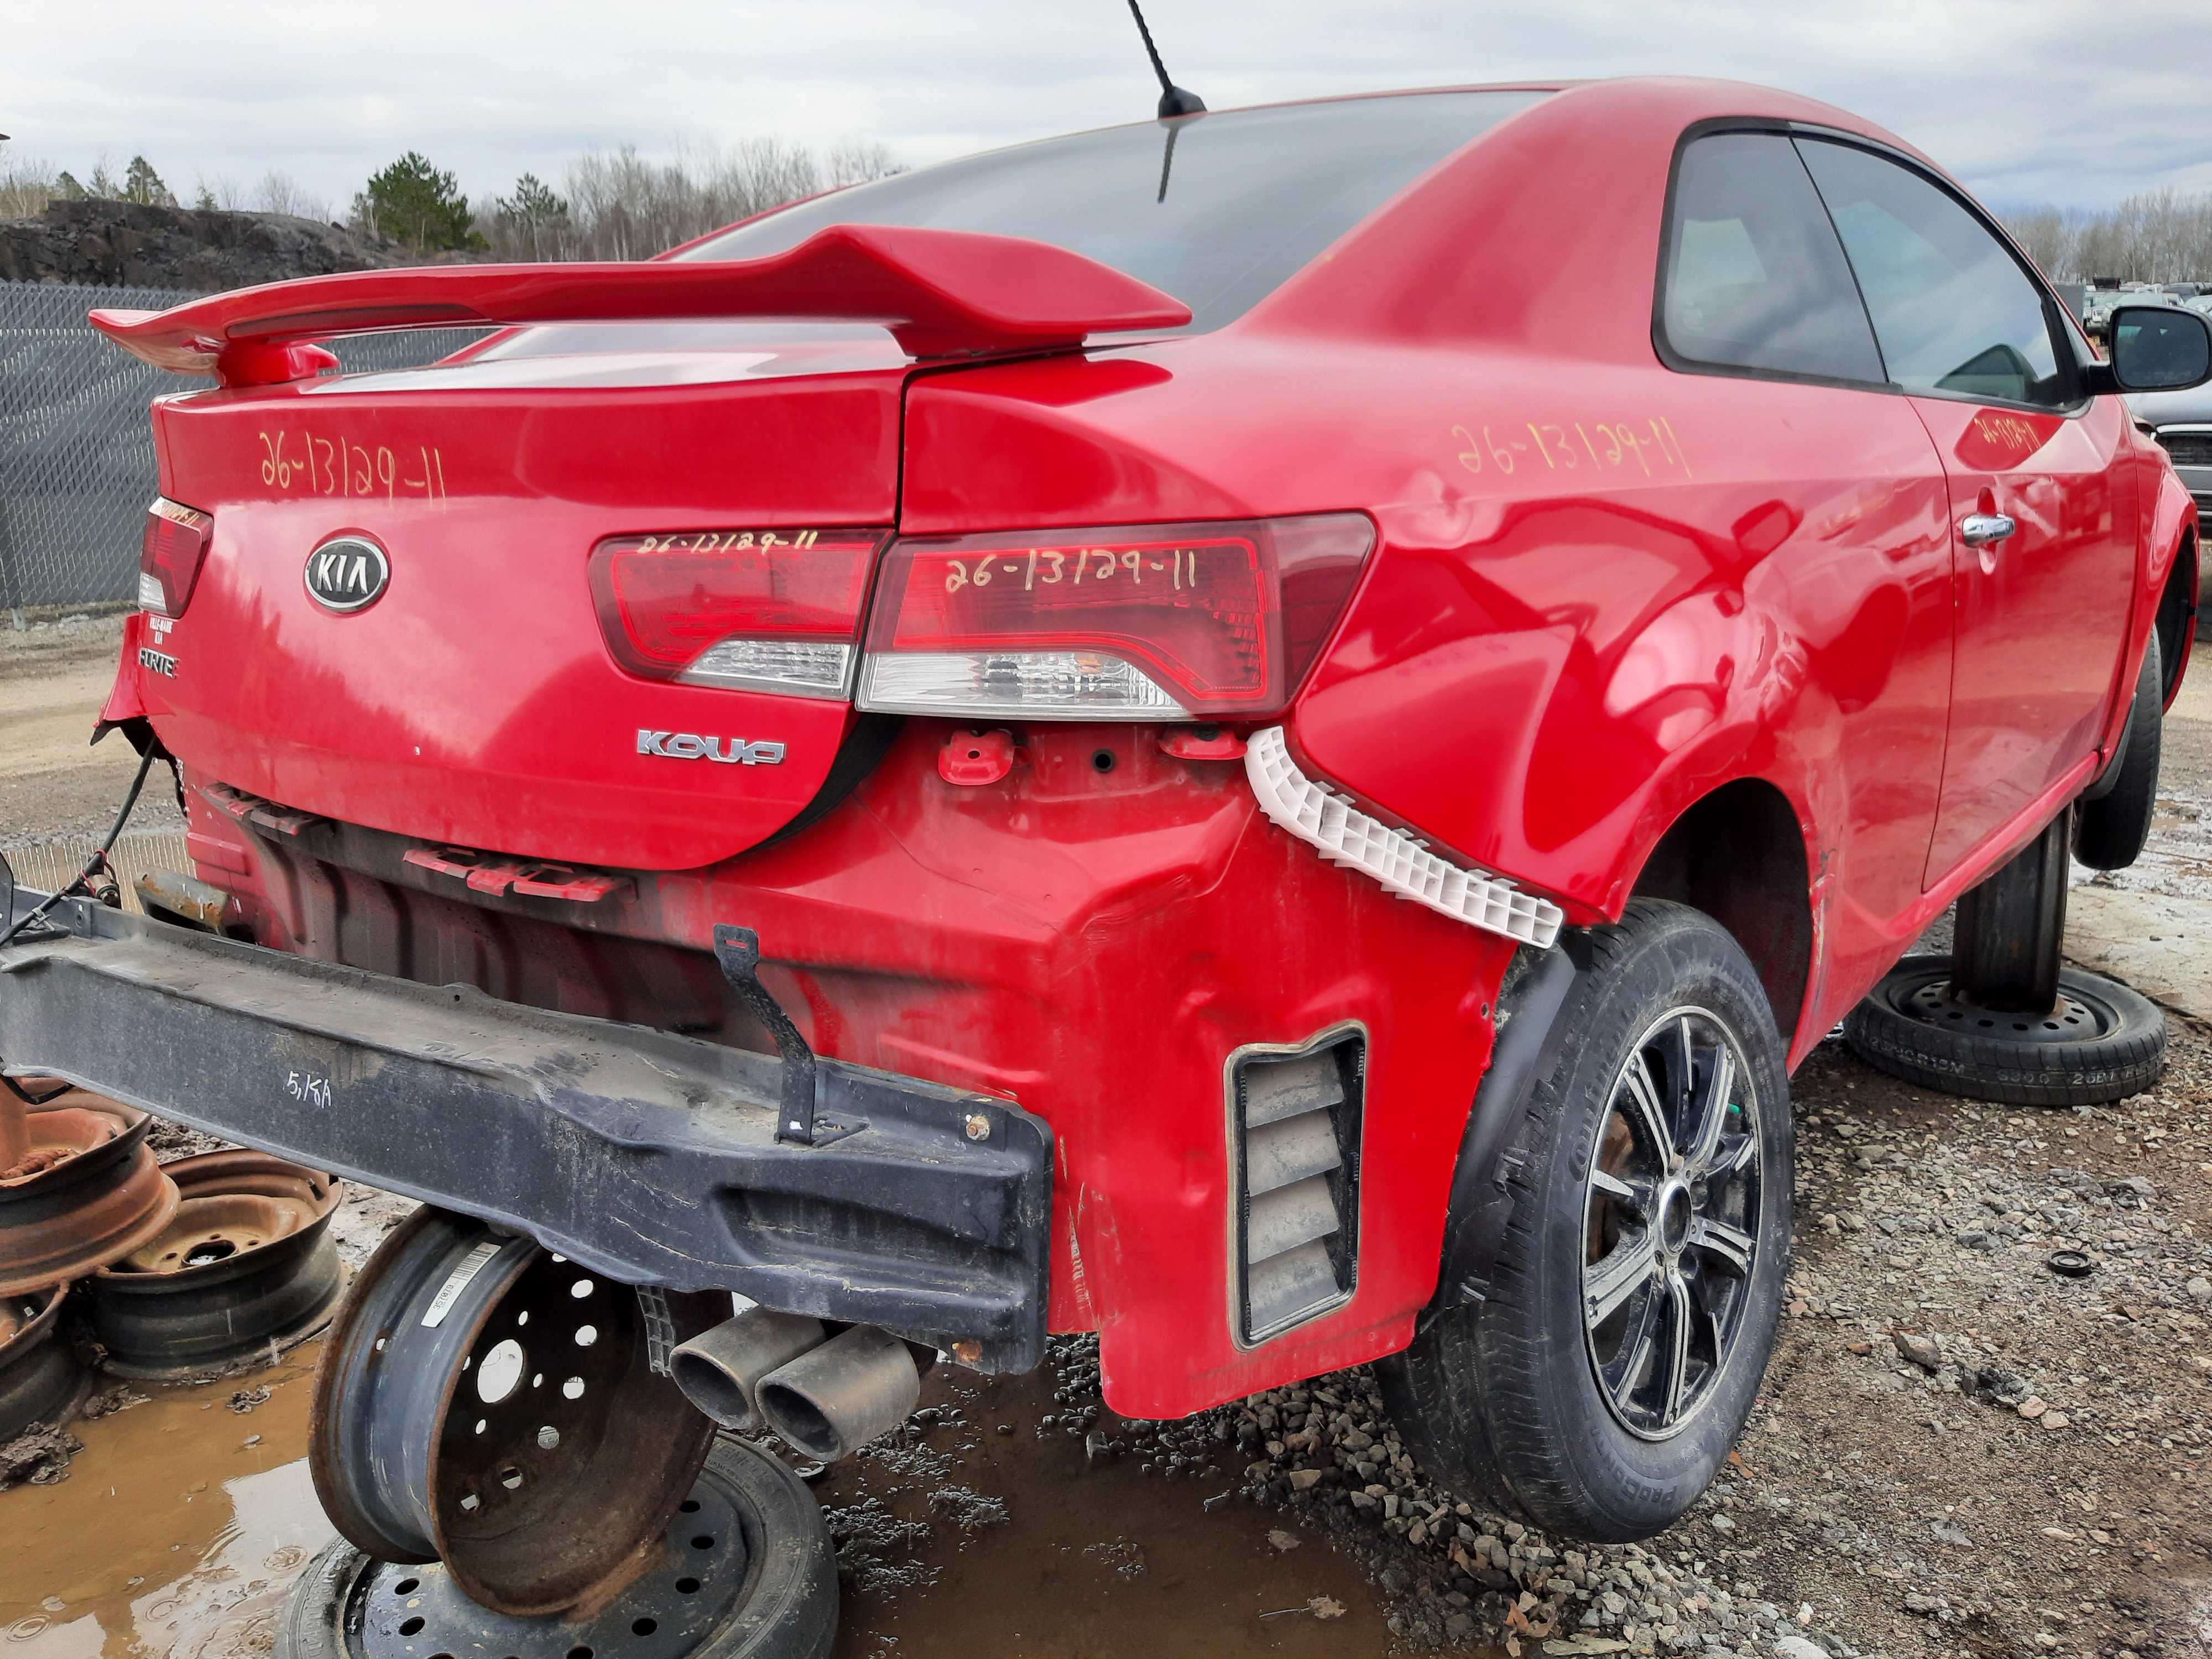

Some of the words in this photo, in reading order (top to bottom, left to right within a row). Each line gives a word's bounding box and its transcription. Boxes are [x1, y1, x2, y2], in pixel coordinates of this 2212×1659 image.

[1451, 416, 1692, 479] 26-13129-11
[259, 430, 447, 513] 26-13129-11
[316, 553, 369, 595] KIA
[945, 549, 1196, 594] 26-13129-11
[636, 728, 787, 765] KOUP
[433, 1284, 453, 1310] 357079
